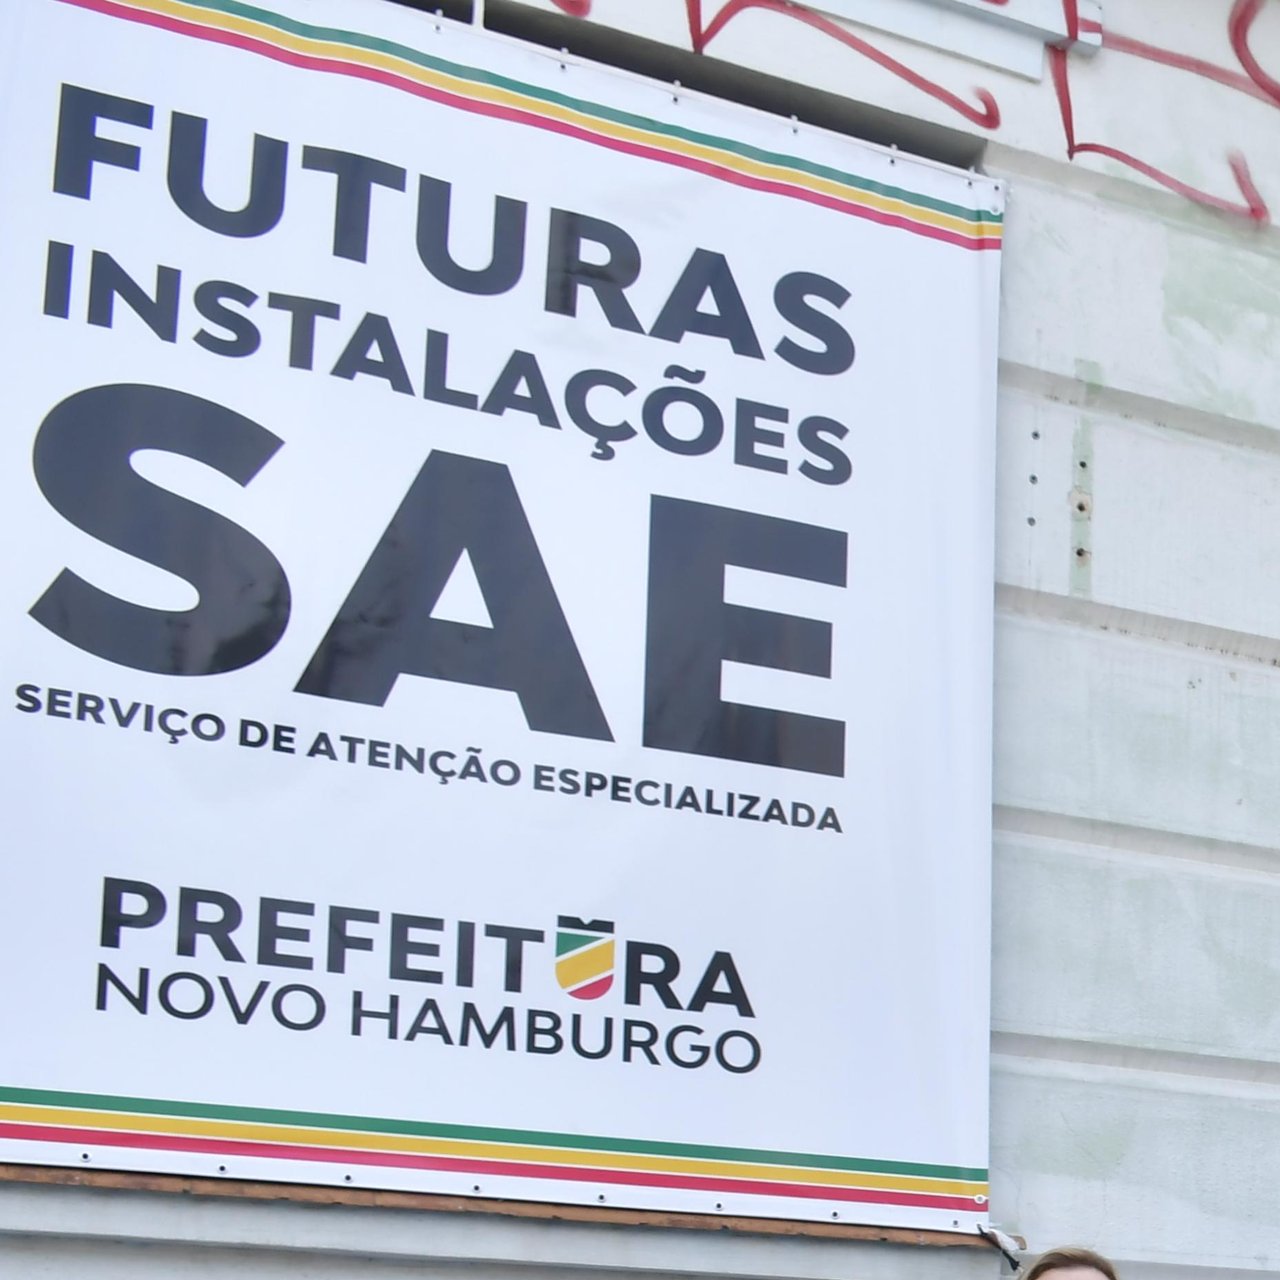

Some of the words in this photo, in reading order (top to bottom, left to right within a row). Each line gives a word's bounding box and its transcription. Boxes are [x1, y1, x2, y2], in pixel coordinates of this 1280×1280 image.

[52, 82, 856, 376] FUTURAS
[42, 240, 853, 486] INSTALAÇÕES
[28, 383, 848, 778] SAE
[15, 683, 226, 745] SERVIÇO
[239, 718, 296, 754] DE
[306, 732, 521, 787] ATENÇÃO
[534, 764, 843, 833] ESPECIALIZADA
[96, 962, 326, 1031] NOVO
[351, 990, 761, 1074] HAMBURGO
[100, 876, 756, 1019] PREFEITURA
